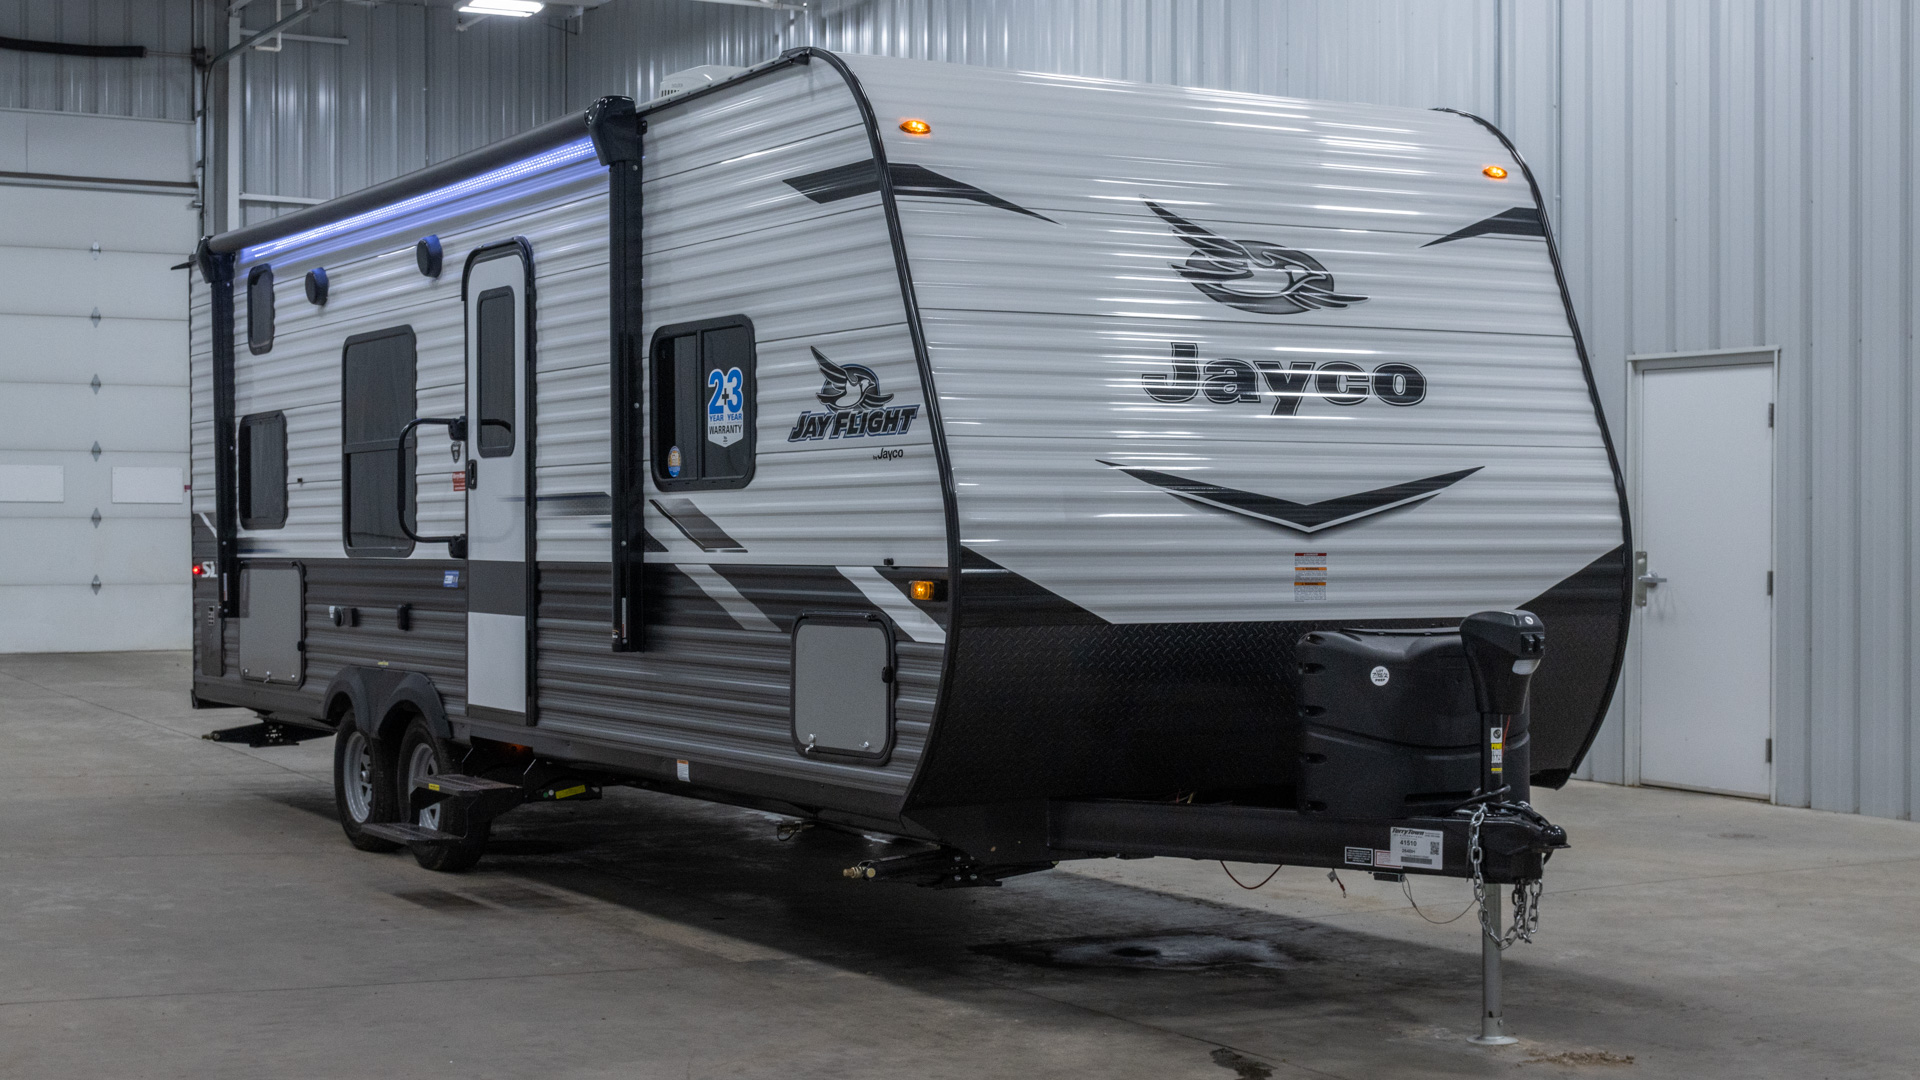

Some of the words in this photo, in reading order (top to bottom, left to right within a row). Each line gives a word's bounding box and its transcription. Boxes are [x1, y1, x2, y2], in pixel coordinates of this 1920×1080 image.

[1142, 342, 1427, 416] Jayco
[727, 413, 742, 421] YEAR
[788, 411, 832, 442] JAY
[829, 404, 920, 439] FLIGHT
[709, 425, 743, 435] WARRANTY
[878, 448, 903, 461] Jayco
[202, 561, 218, 578] SL
